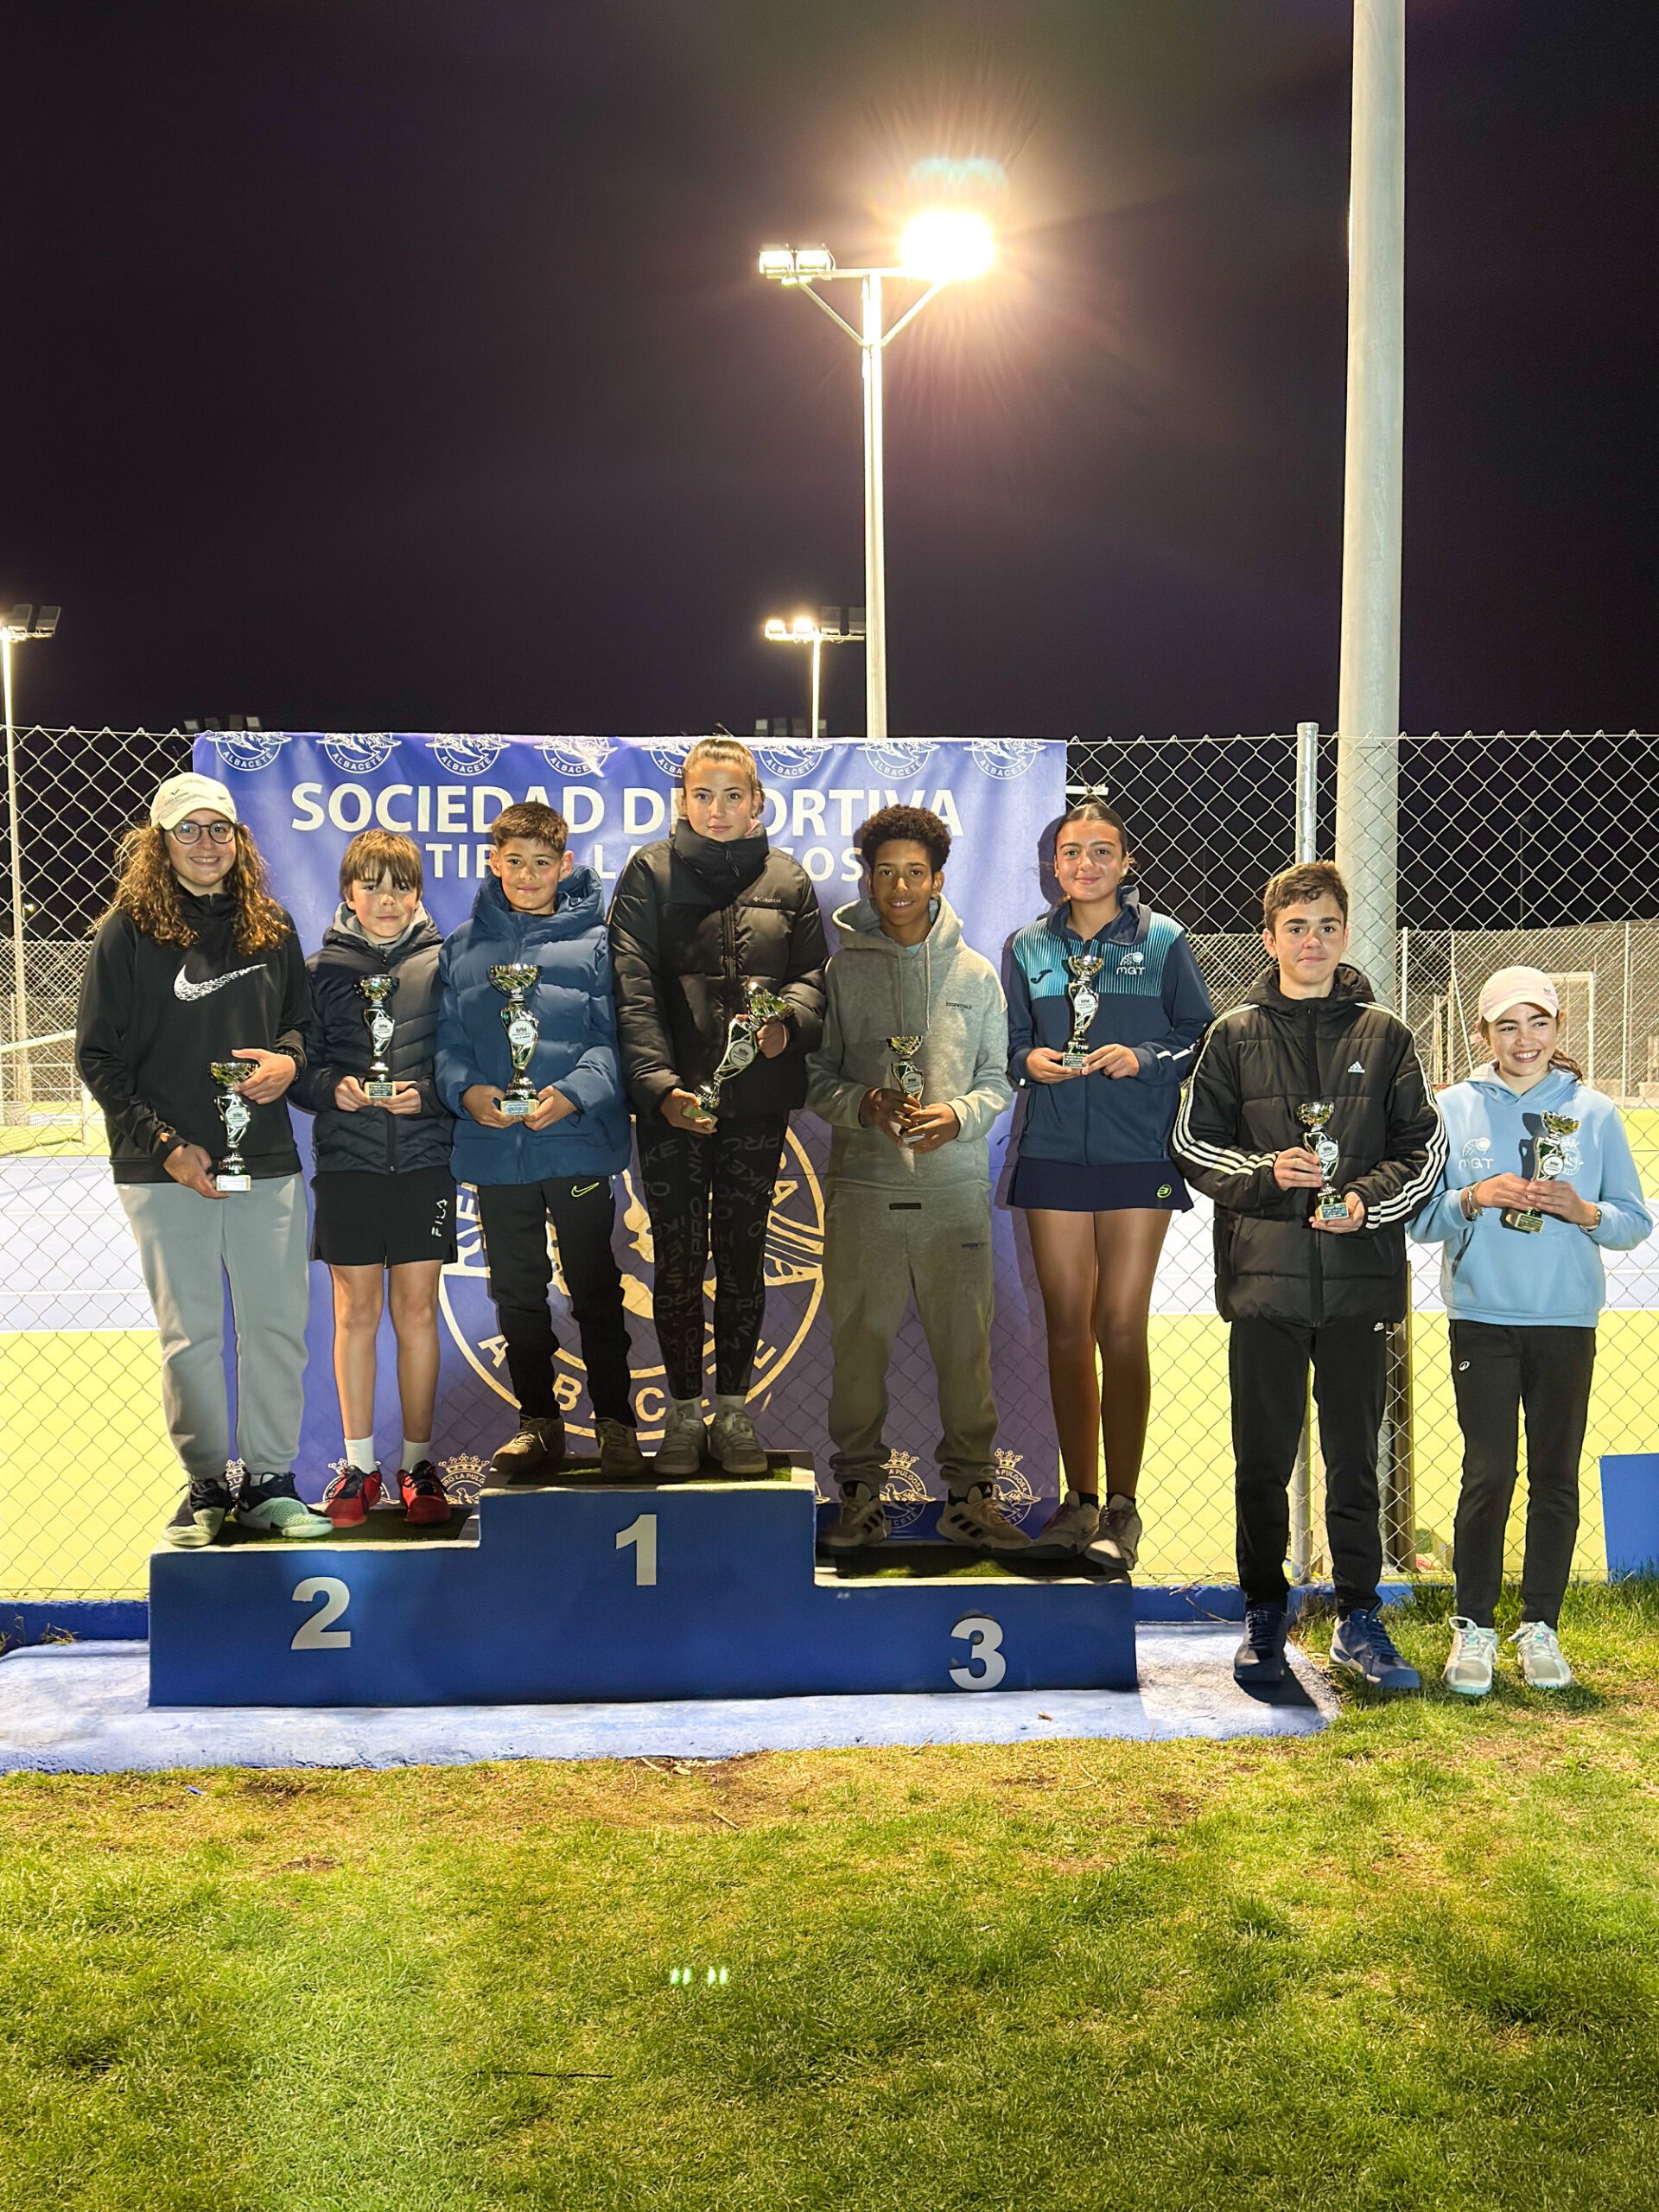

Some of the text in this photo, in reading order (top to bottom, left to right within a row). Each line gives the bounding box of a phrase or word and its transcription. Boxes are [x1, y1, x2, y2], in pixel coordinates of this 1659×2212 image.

[223, 751, 274, 768] ALBACETE
[332, 753, 383, 771] ALBACETE
[441, 755, 492, 773] ALBACETE
[550, 757, 600, 774] ALBACE
[766, 759, 816, 777] ALBACETE
[873, 760, 922, 777] ALBACETE
[979, 760, 1028, 778] ALBACETE
[431, 1198, 448, 1237] FILA
[616, 1514, 657, 1586] 1
[291, 1576, 351, 1650] 2
[950, 1618, 1007, 1690] 3
